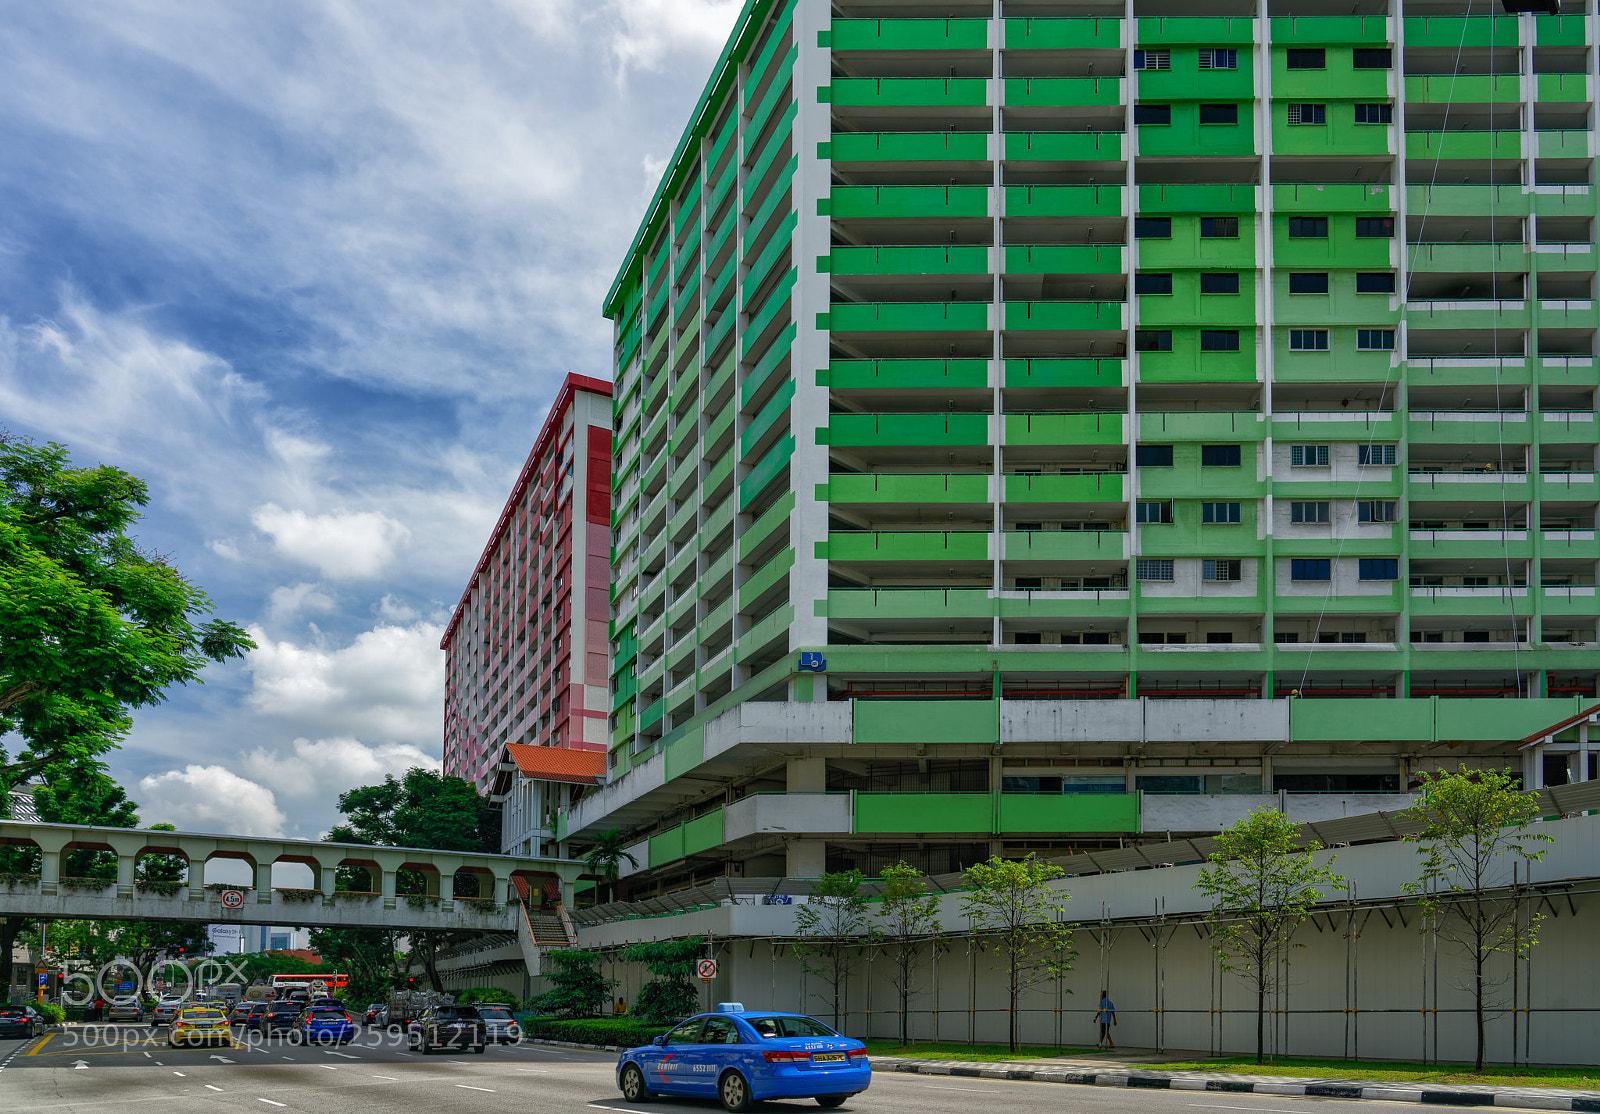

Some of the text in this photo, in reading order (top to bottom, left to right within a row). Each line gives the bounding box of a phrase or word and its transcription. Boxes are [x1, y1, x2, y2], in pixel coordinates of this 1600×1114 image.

[225, 894, 240, 903] 4.5m
[212, 927, 231, 936] Galaxy
[692, 1064, 706, 1072] 6552
